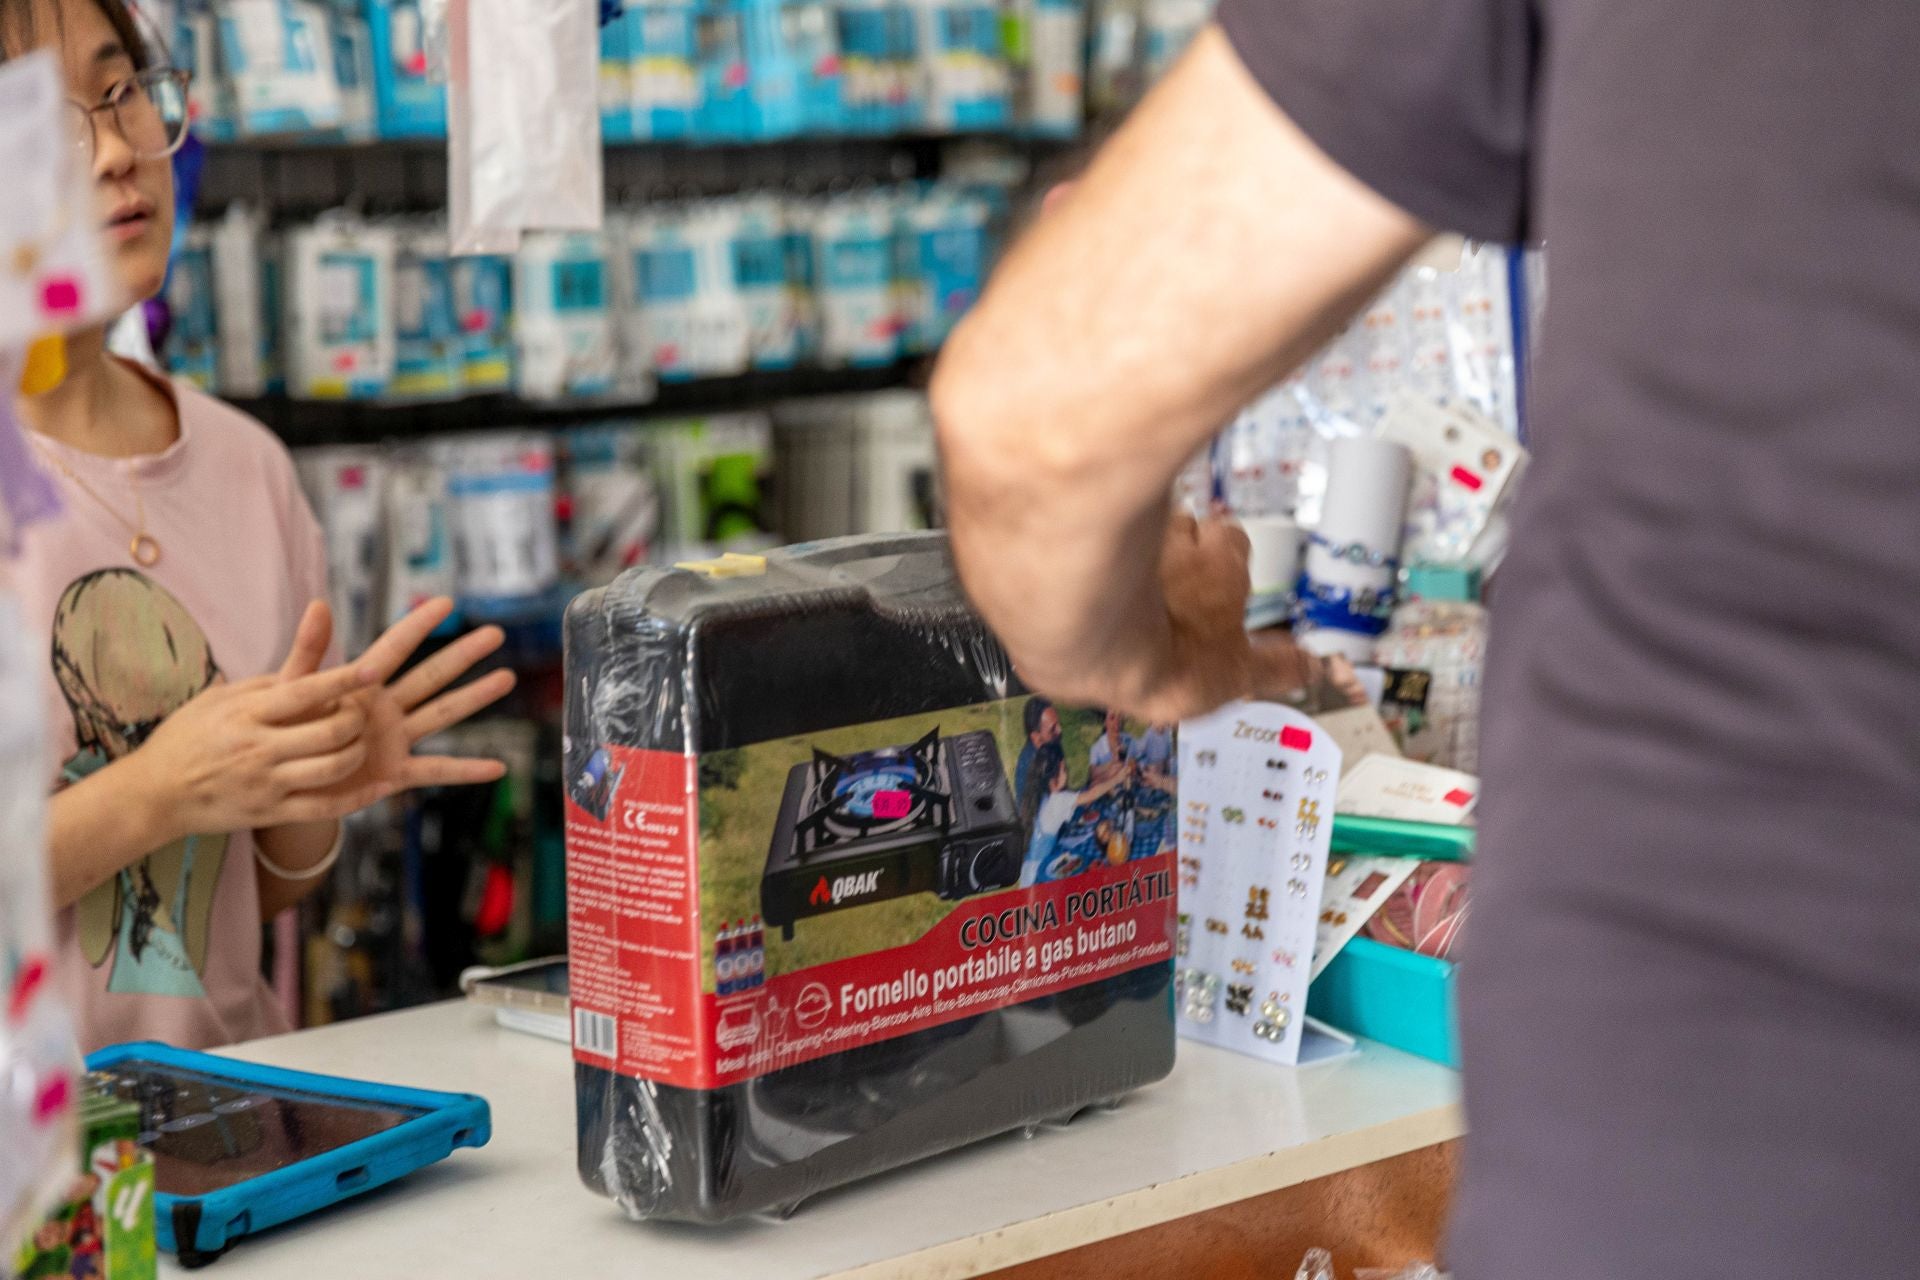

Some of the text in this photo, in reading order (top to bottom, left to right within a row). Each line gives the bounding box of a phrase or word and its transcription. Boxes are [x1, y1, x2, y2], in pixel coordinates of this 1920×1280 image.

[831, 869, 879, 904] QBAK
[959, 868, 1175, 951] COCINA PORTÁTIL
[840, 918, 1137, 1017] Fornello portabile a gas butano
